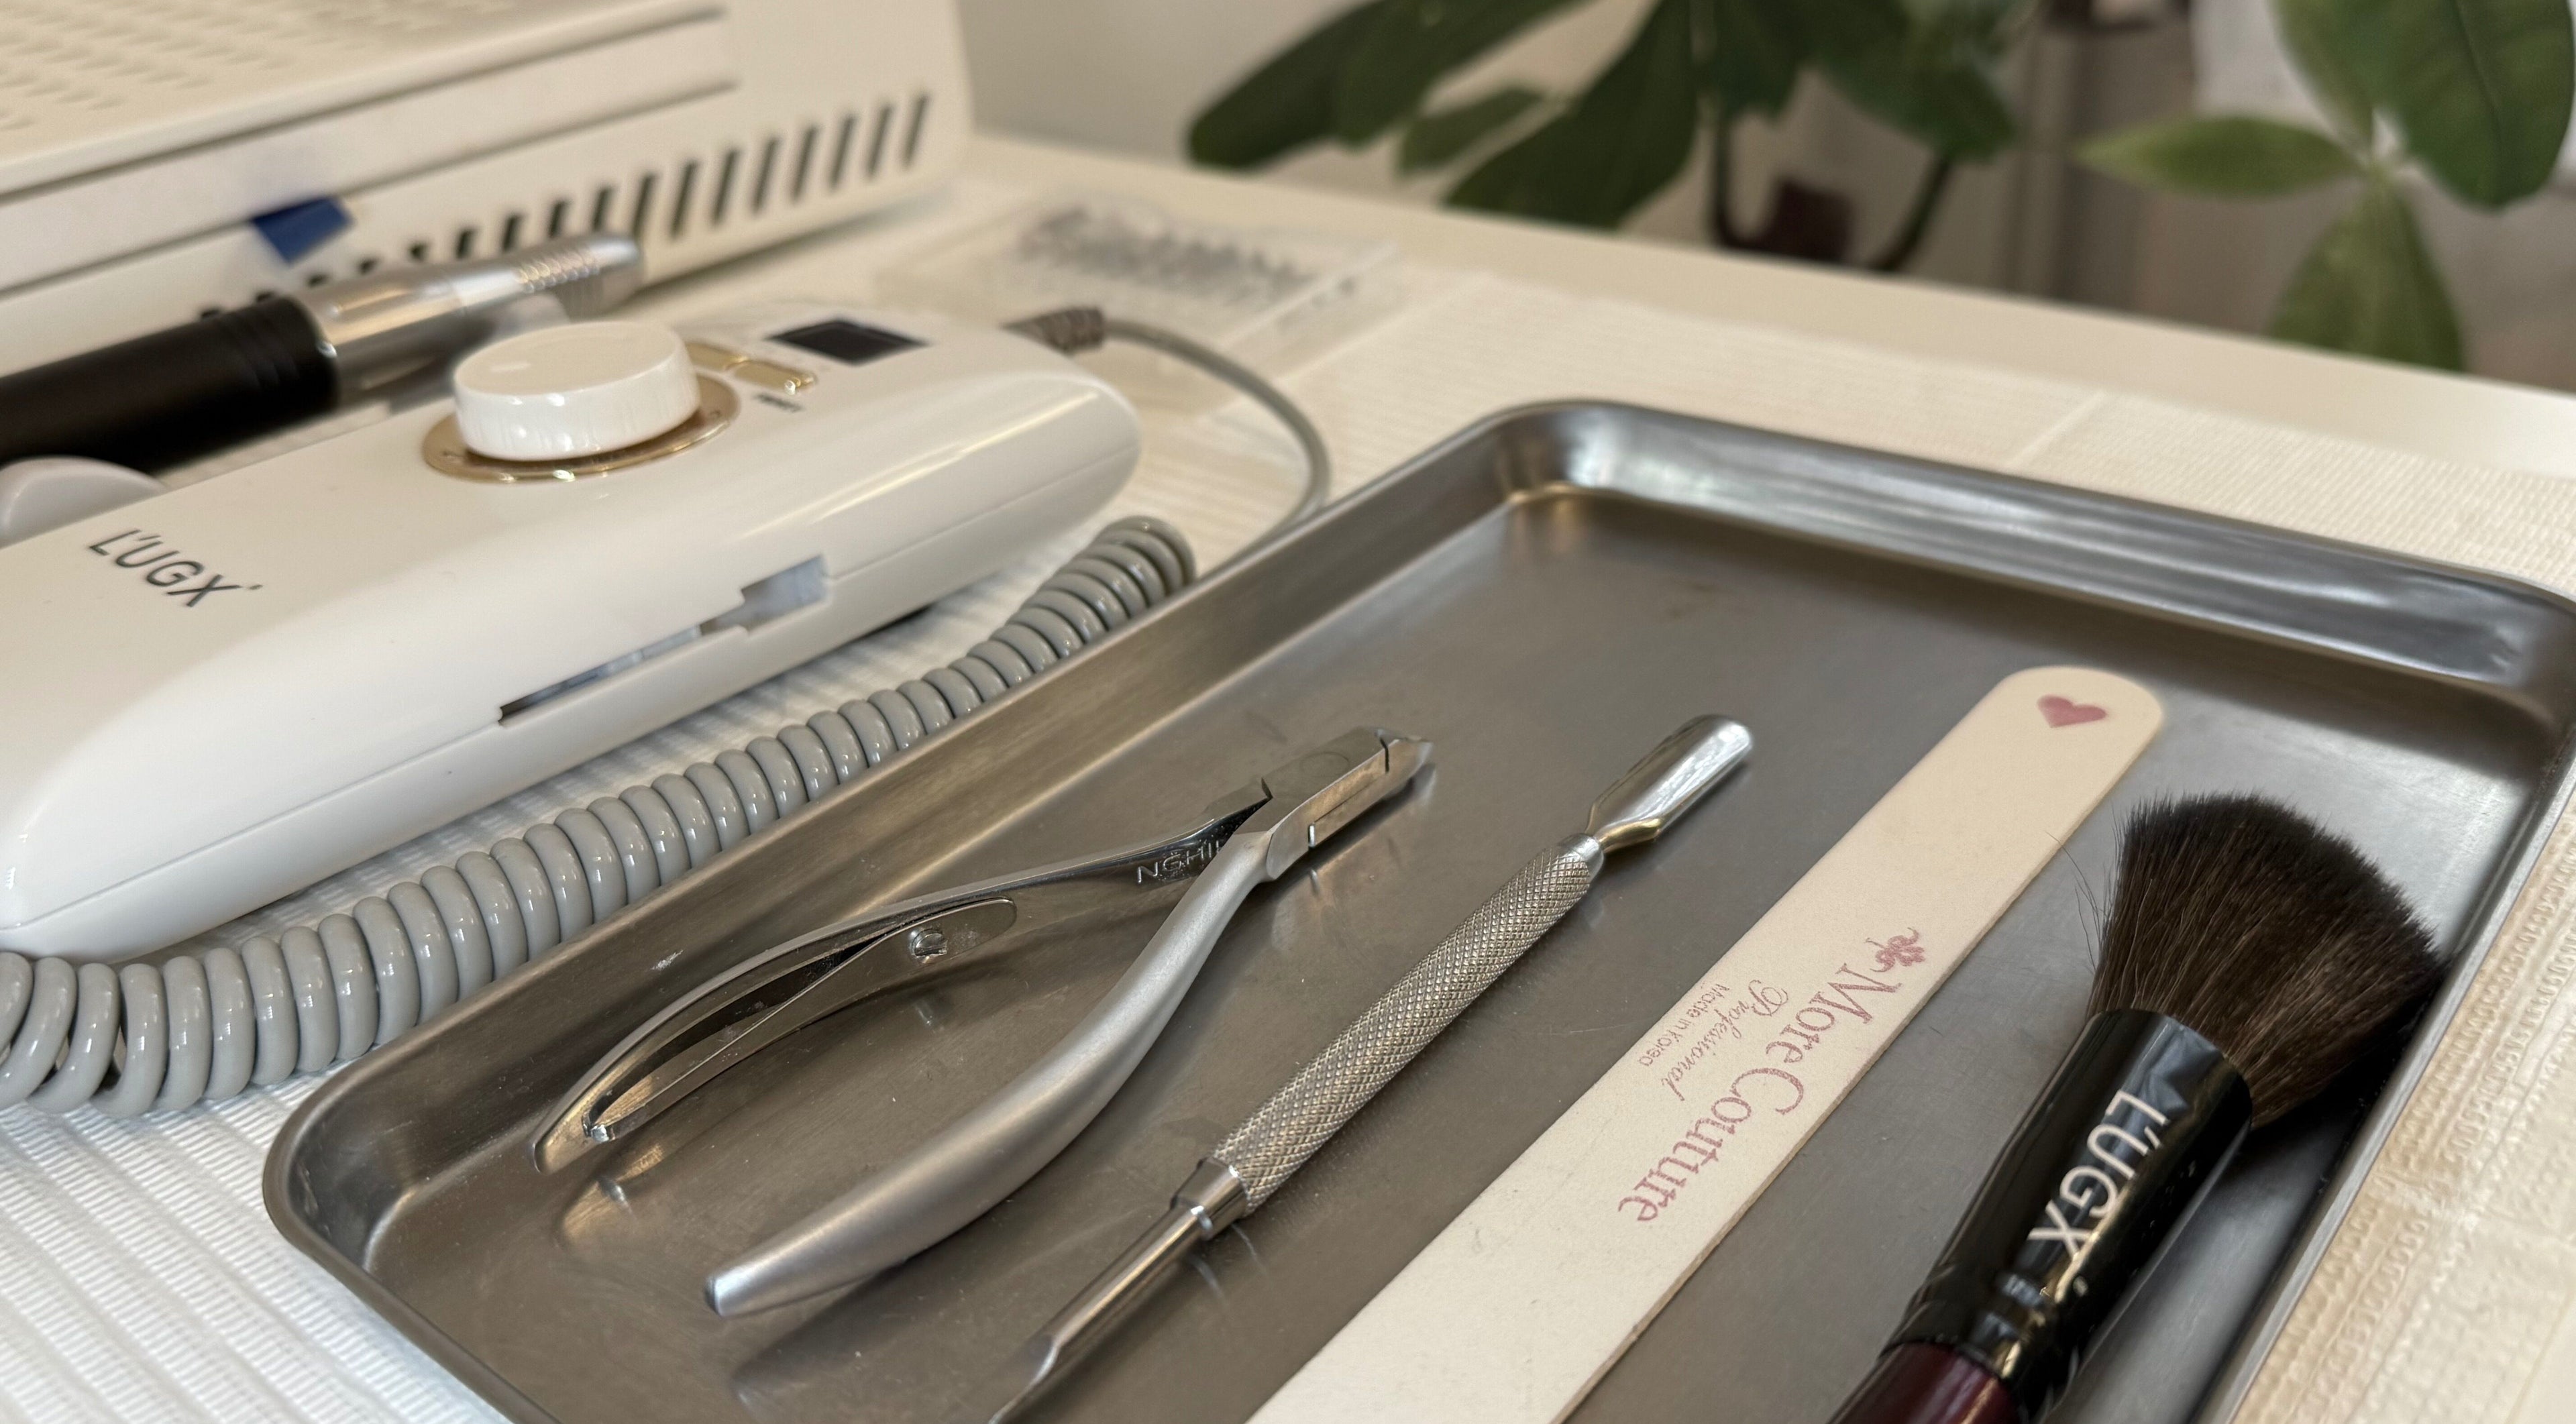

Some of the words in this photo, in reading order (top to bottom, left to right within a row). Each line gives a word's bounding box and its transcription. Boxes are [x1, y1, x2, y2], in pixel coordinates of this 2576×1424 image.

[1686, 983, 1730, 1018] Made
[1660, 979, 1789, 1101] Professional
[1674, 1018, 1692, 1031] in
[1638, 1029, 1683, 1066] Korea
